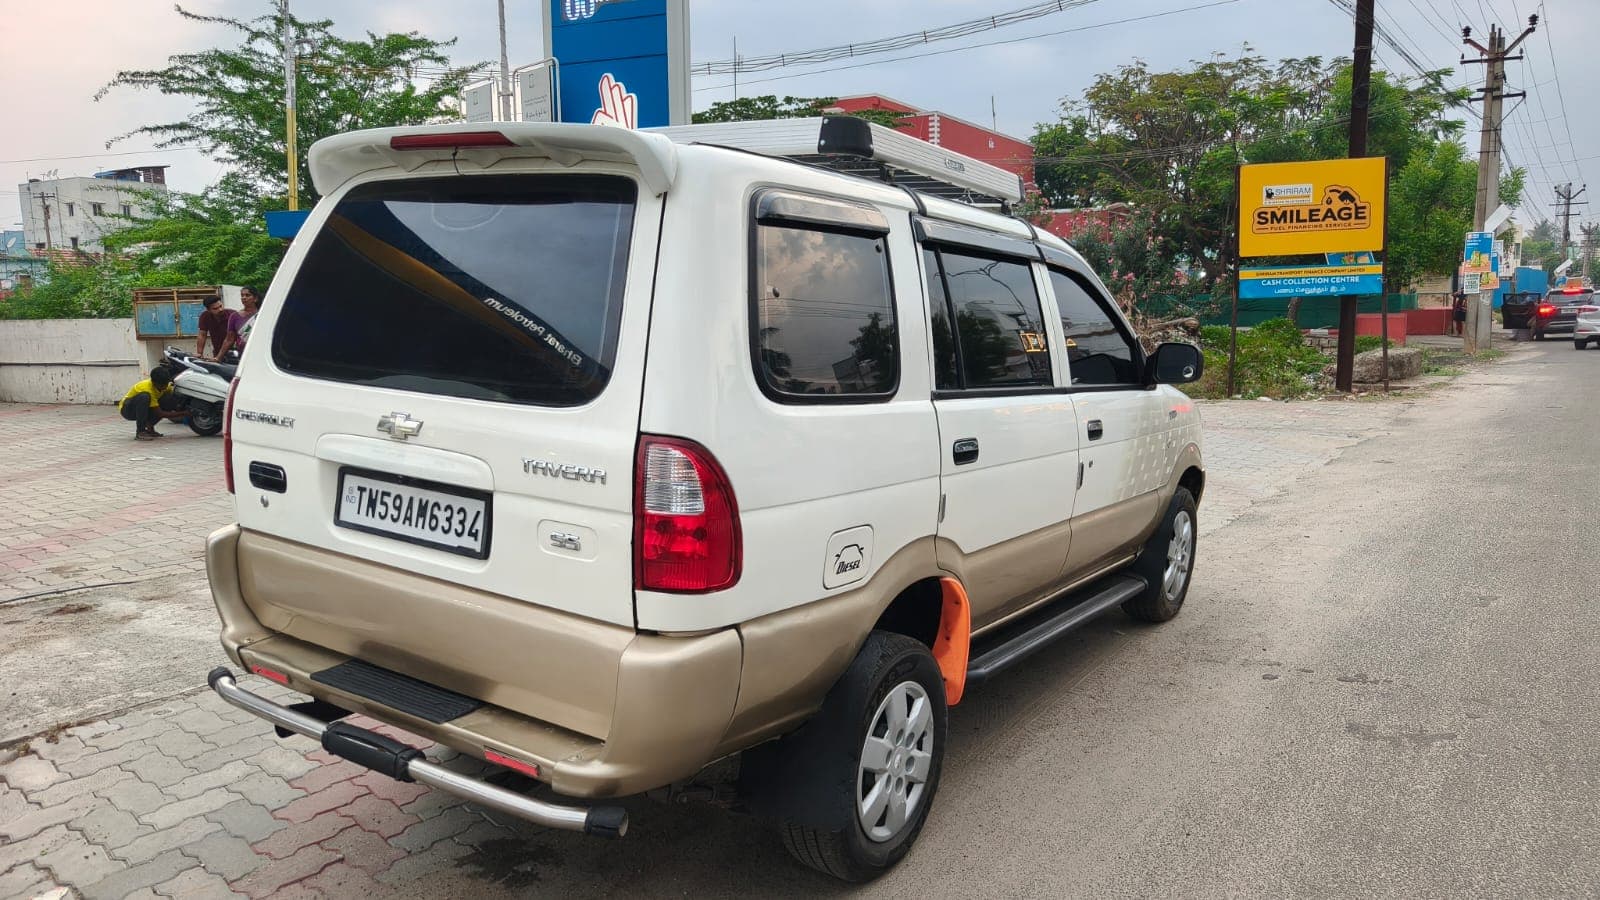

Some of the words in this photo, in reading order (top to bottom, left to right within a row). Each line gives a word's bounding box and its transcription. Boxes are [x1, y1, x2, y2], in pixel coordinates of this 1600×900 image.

[1275, 186, 1312, 196] SHRIRAM
[1256, 205, 1367, 225] SMILEAGE
[1282, 277, 1329, 285] COLLECTION
[522, 457, 607, 485] TAVERA
[356, 485, 481, 541] TN59AM6334
